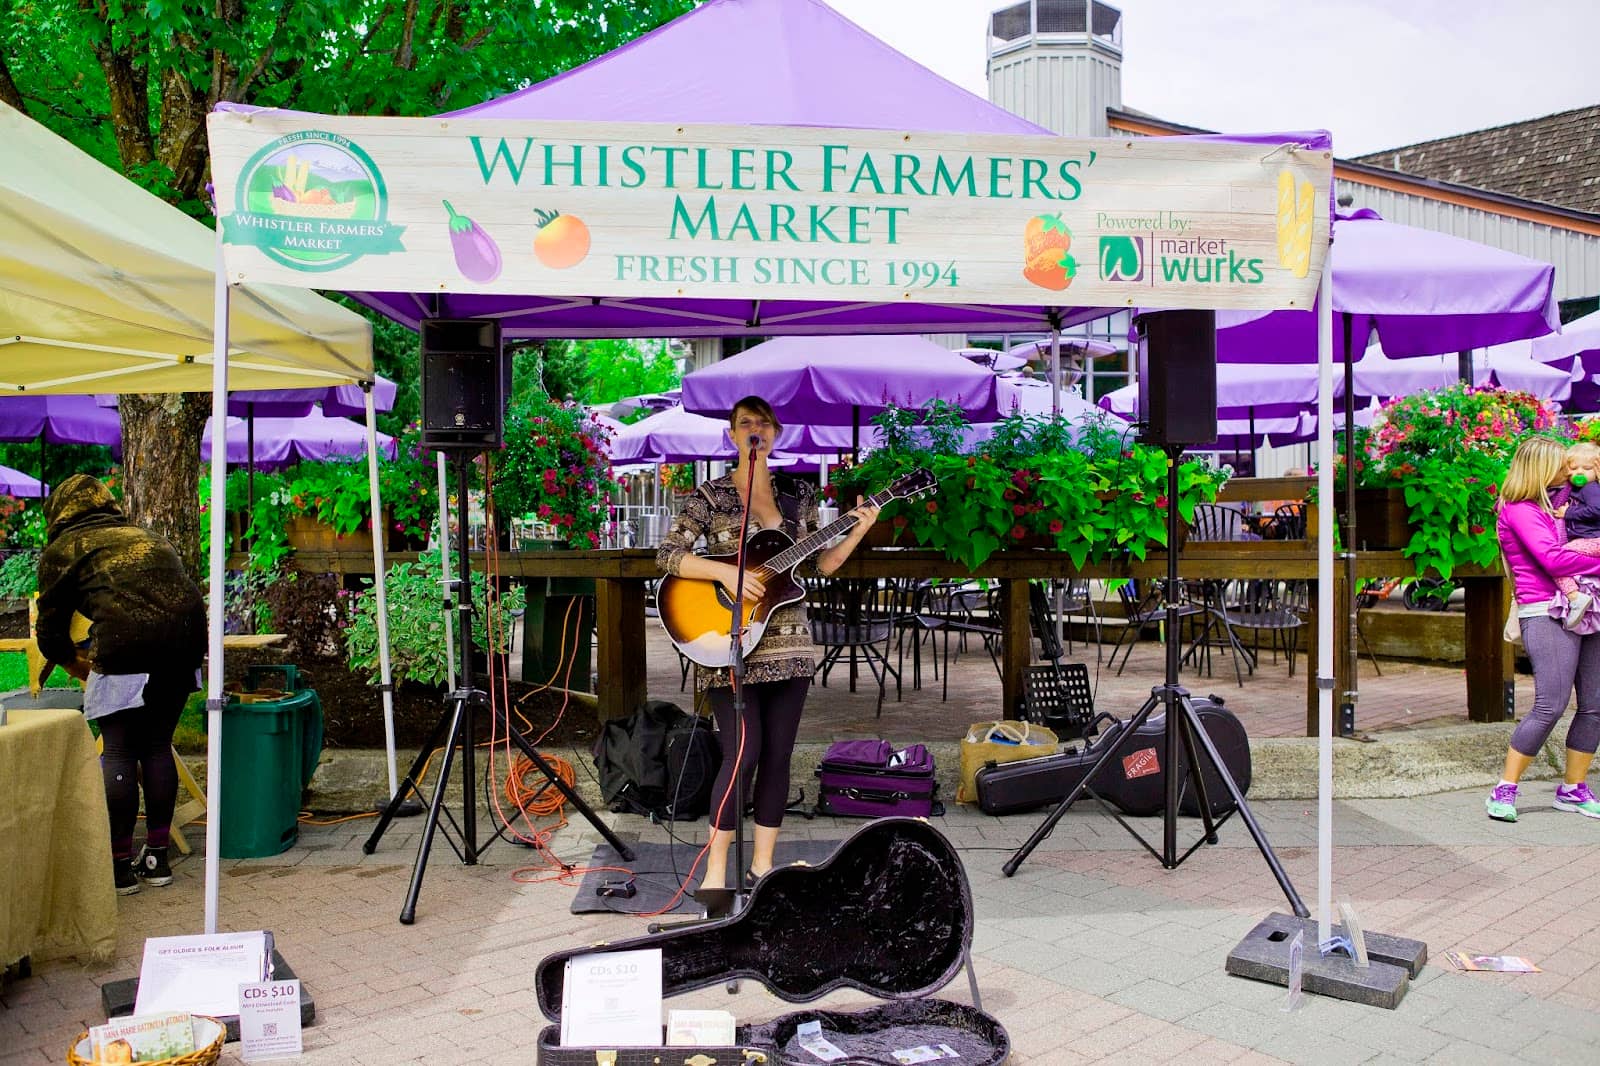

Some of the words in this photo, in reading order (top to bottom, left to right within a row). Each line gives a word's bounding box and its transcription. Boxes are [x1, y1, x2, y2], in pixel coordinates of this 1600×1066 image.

[278, 133, 302, 146] FRESH
[306, 132, 330, 140] SINCE
[332, 135, 351, 148] 1994
[466, 135, 804, 192] WHISTLER
[236, 214, 313, 233] WHISTLER
[667, 193, 909, 245] MARKET
[1096, 211, 1162, 231] Powered
[1169, 211, 1192, 236] by:
[284, 235, 343, 250] MARKET
[1161, 235, 1227, 255] market
[614, 254, 739, 283] FRESH
[753, 256, 871, 285] SINCE
[887, 259, 960, 289] 1994
[1161, 249, 1265, 284] wurks
[1126, 747, 1156, 778] FRAGILE
[590, 966, 612, 976] CDs
[244, 988, 268, 999] CDs
[271, 985, 294, 999] $10
